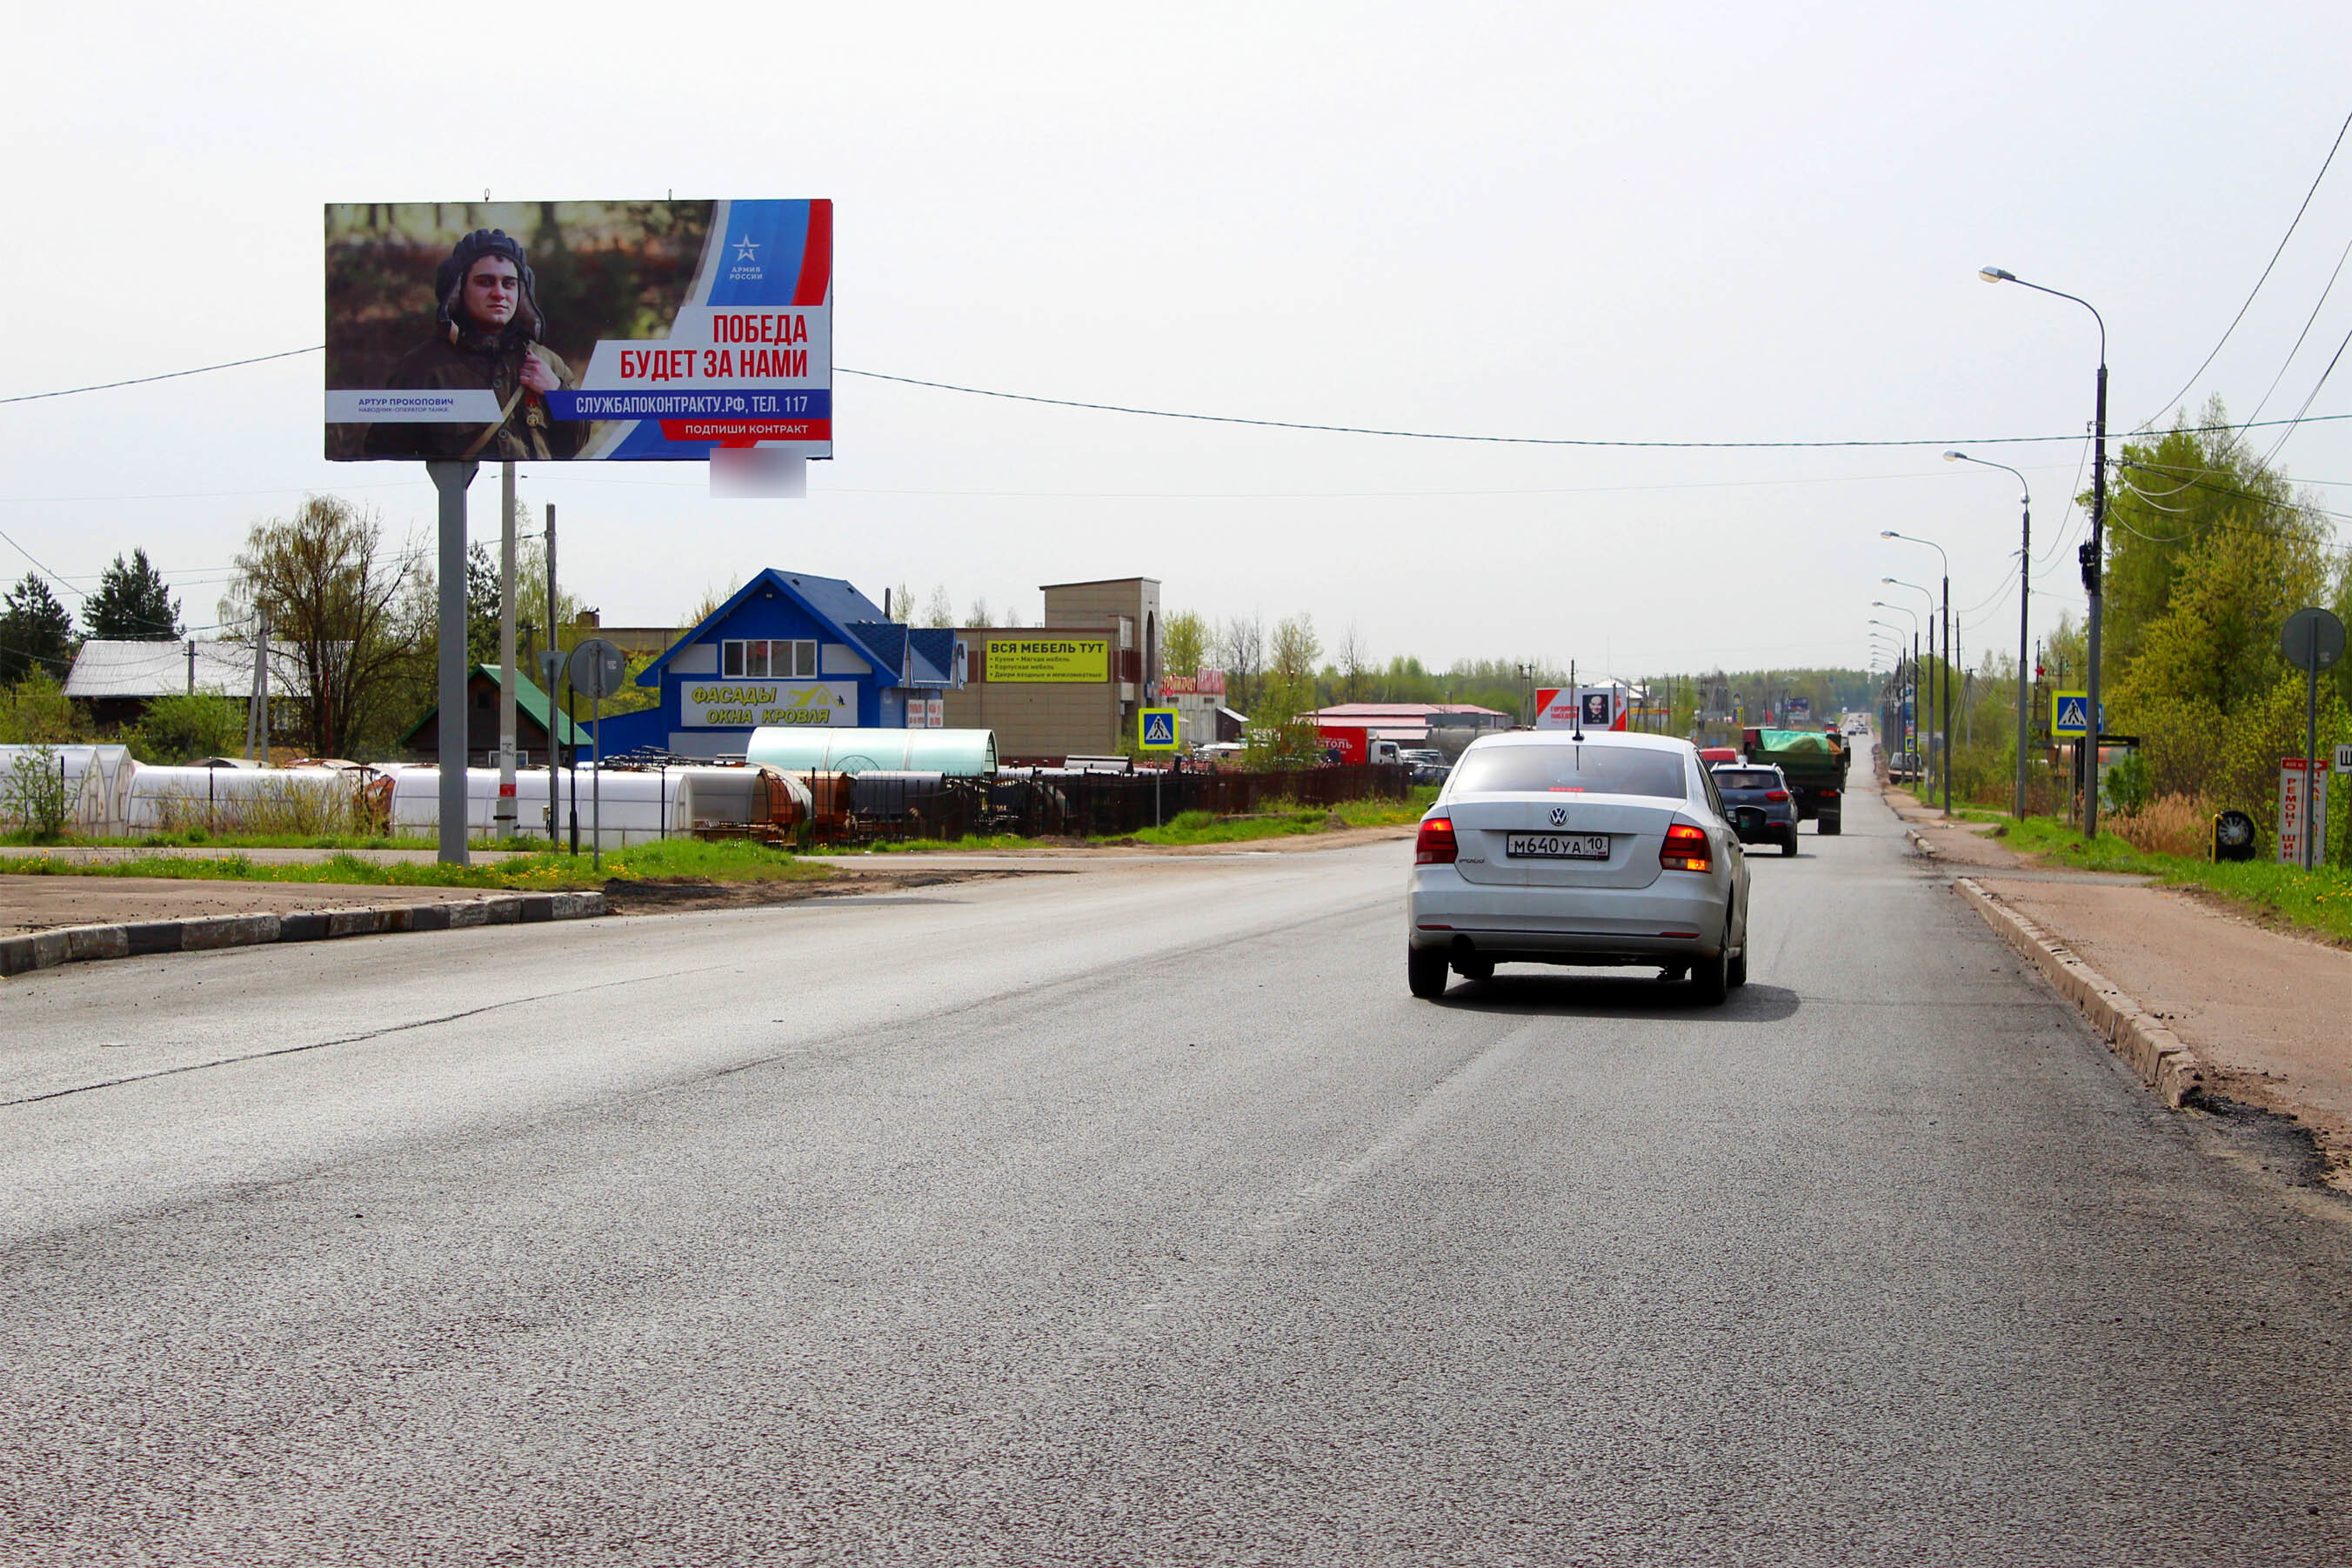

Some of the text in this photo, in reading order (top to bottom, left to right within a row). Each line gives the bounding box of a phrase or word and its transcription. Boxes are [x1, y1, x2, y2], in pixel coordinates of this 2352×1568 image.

[713, 314, 807, 346] ПОБЕДА
[620, 349, 807, 382] БУДЕТ ЗА НАМИ
[575, 396, 808, 414] СЛУЖБАПОКОНТРАКТУ.РФ, ТЕЛ. 117
[685, 424, 808, 435] ПОДПИШИ КОНТРАКТ
[991, 643, 1105, 653] ВСЯ МЕБЕЛЬ ТУТ
[691, 686, 777, 705] ФАСАДЫ
[706, 709, 831, 724] ОКНА КРОВЛЯ
[2285, 778, 2296, 829] РЕМОНТ
[1587, 837, 1603, 850] 10
[2282, 834, 2296, 859] ШИН
